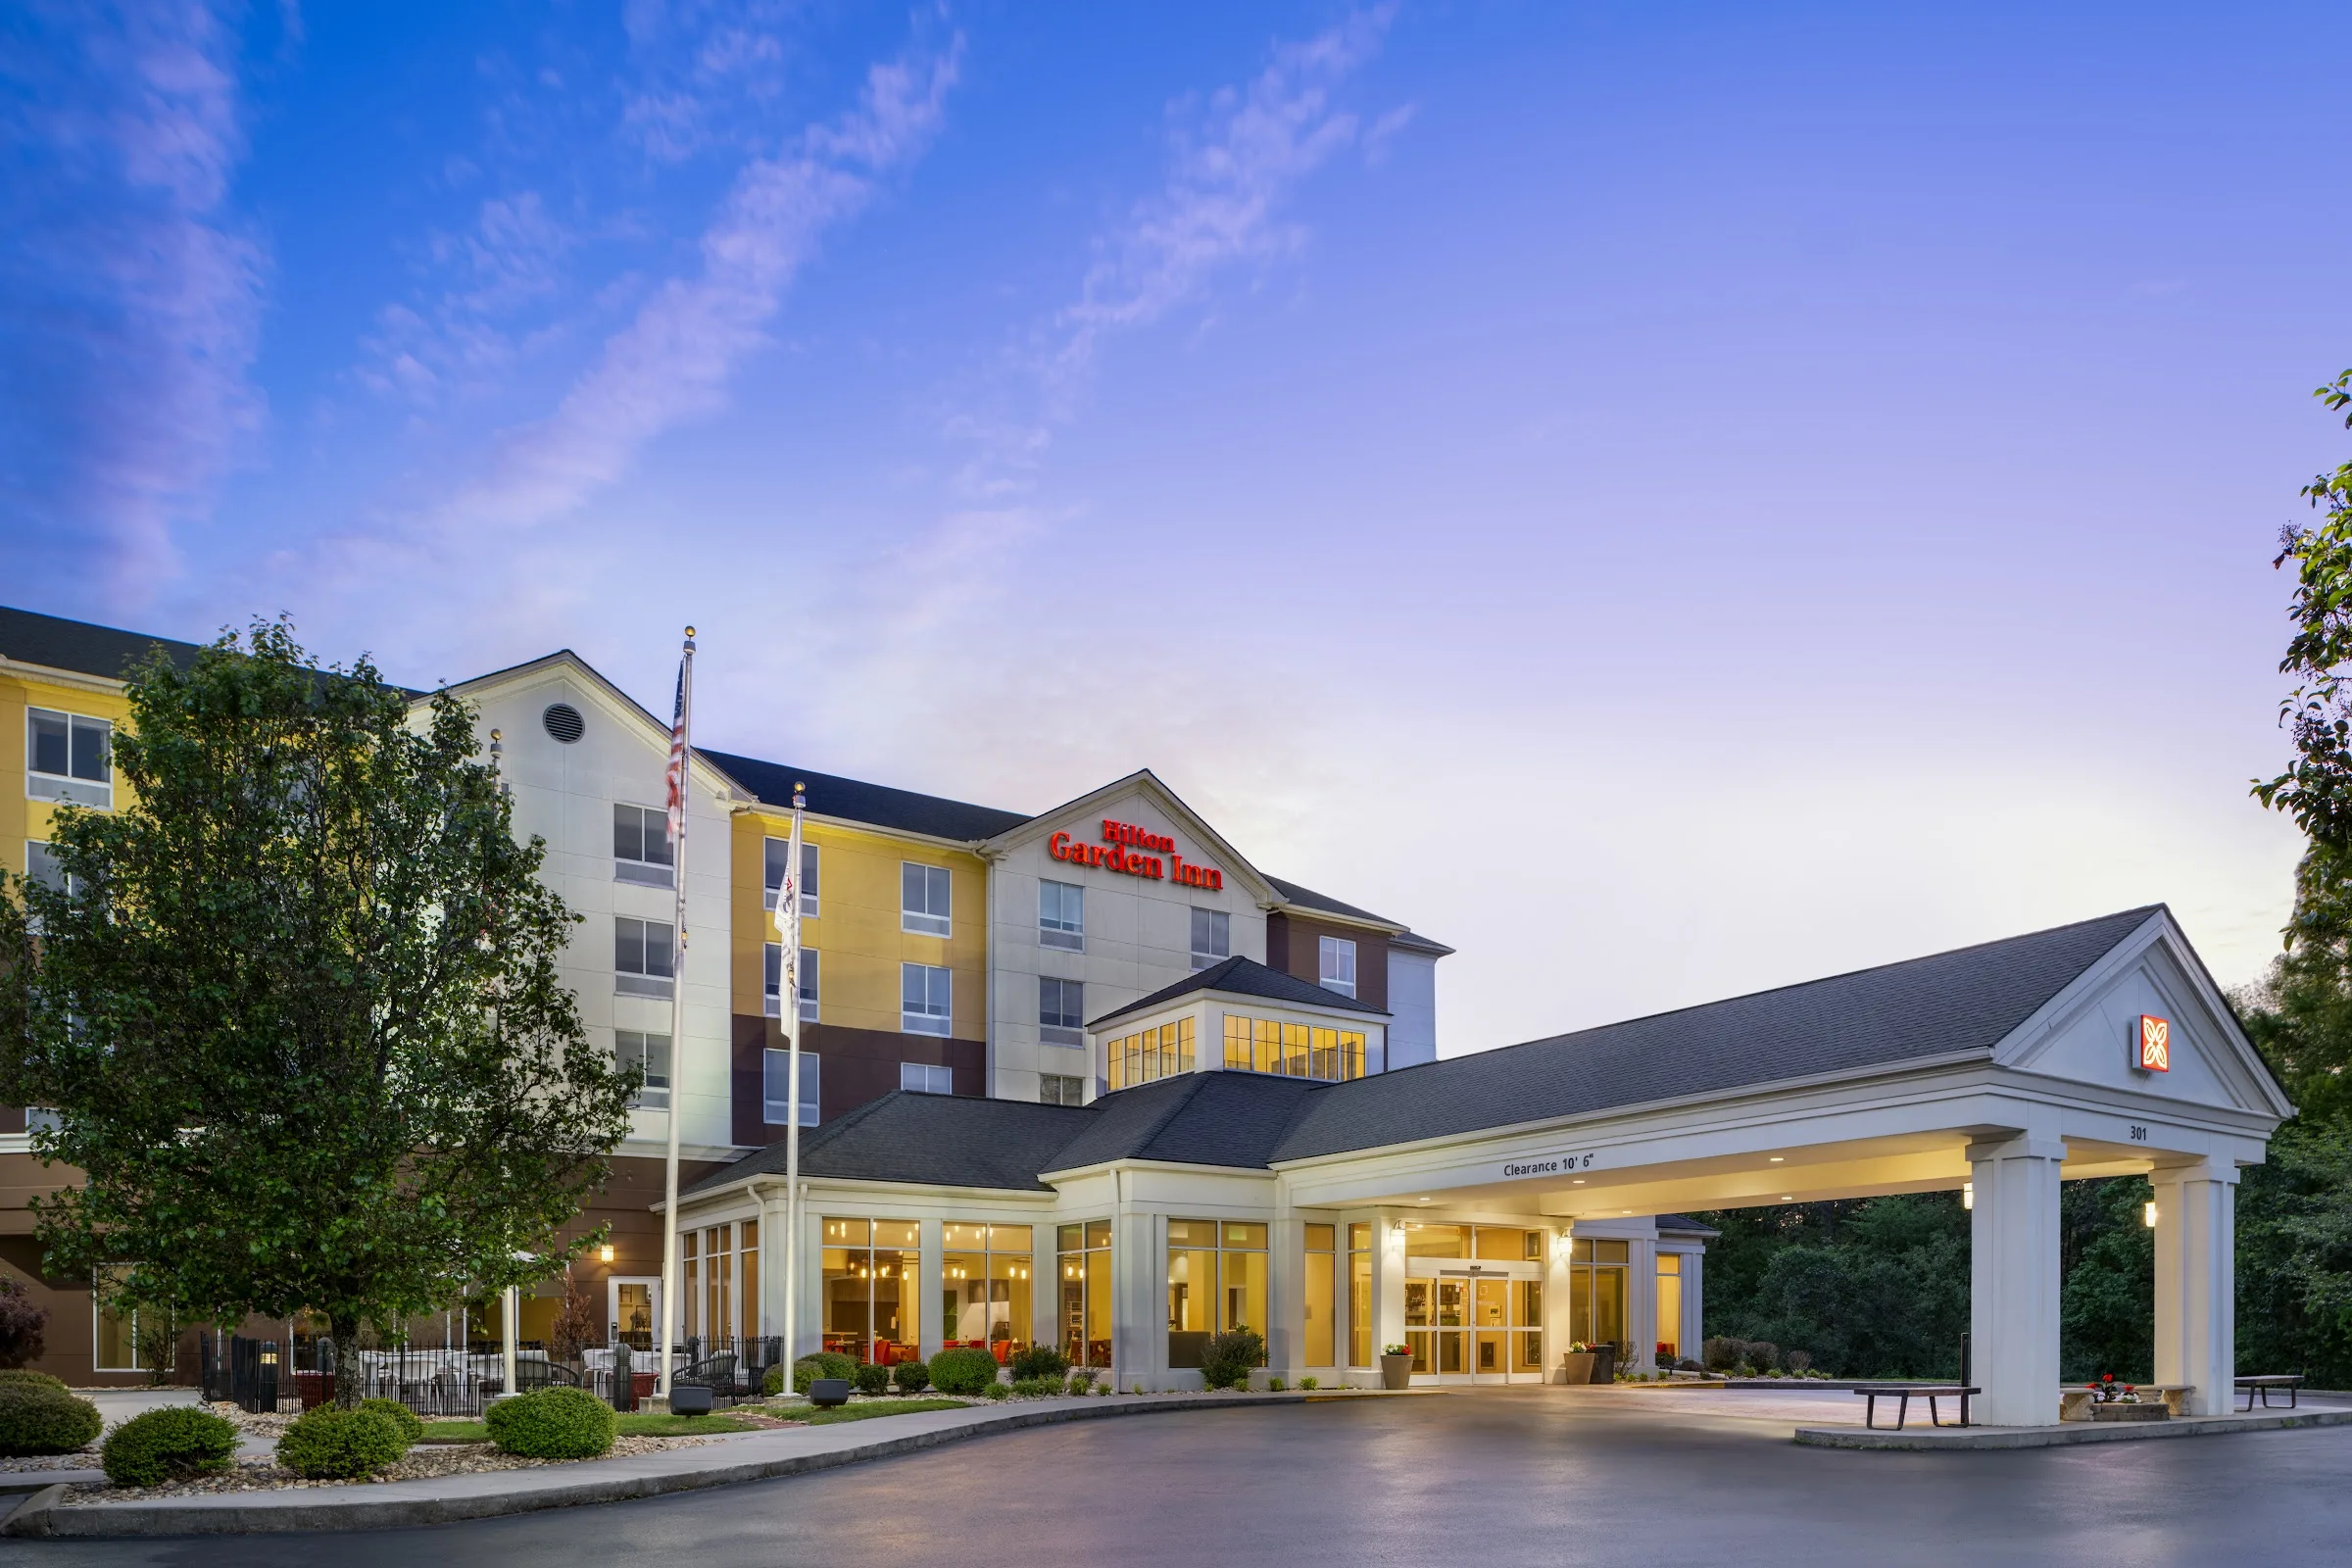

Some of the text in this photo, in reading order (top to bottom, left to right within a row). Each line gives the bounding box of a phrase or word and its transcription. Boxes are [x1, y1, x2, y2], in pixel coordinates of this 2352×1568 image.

[1102, 819, 1175, 853] Hilton
[1050, 831, 1223, 891] Garden Inn
[2131, 1125, 2147, 1141] 301
[1503, 1161, 1557, 1176] Clearance
[1562, 1156, 1578, 1170] 10'
